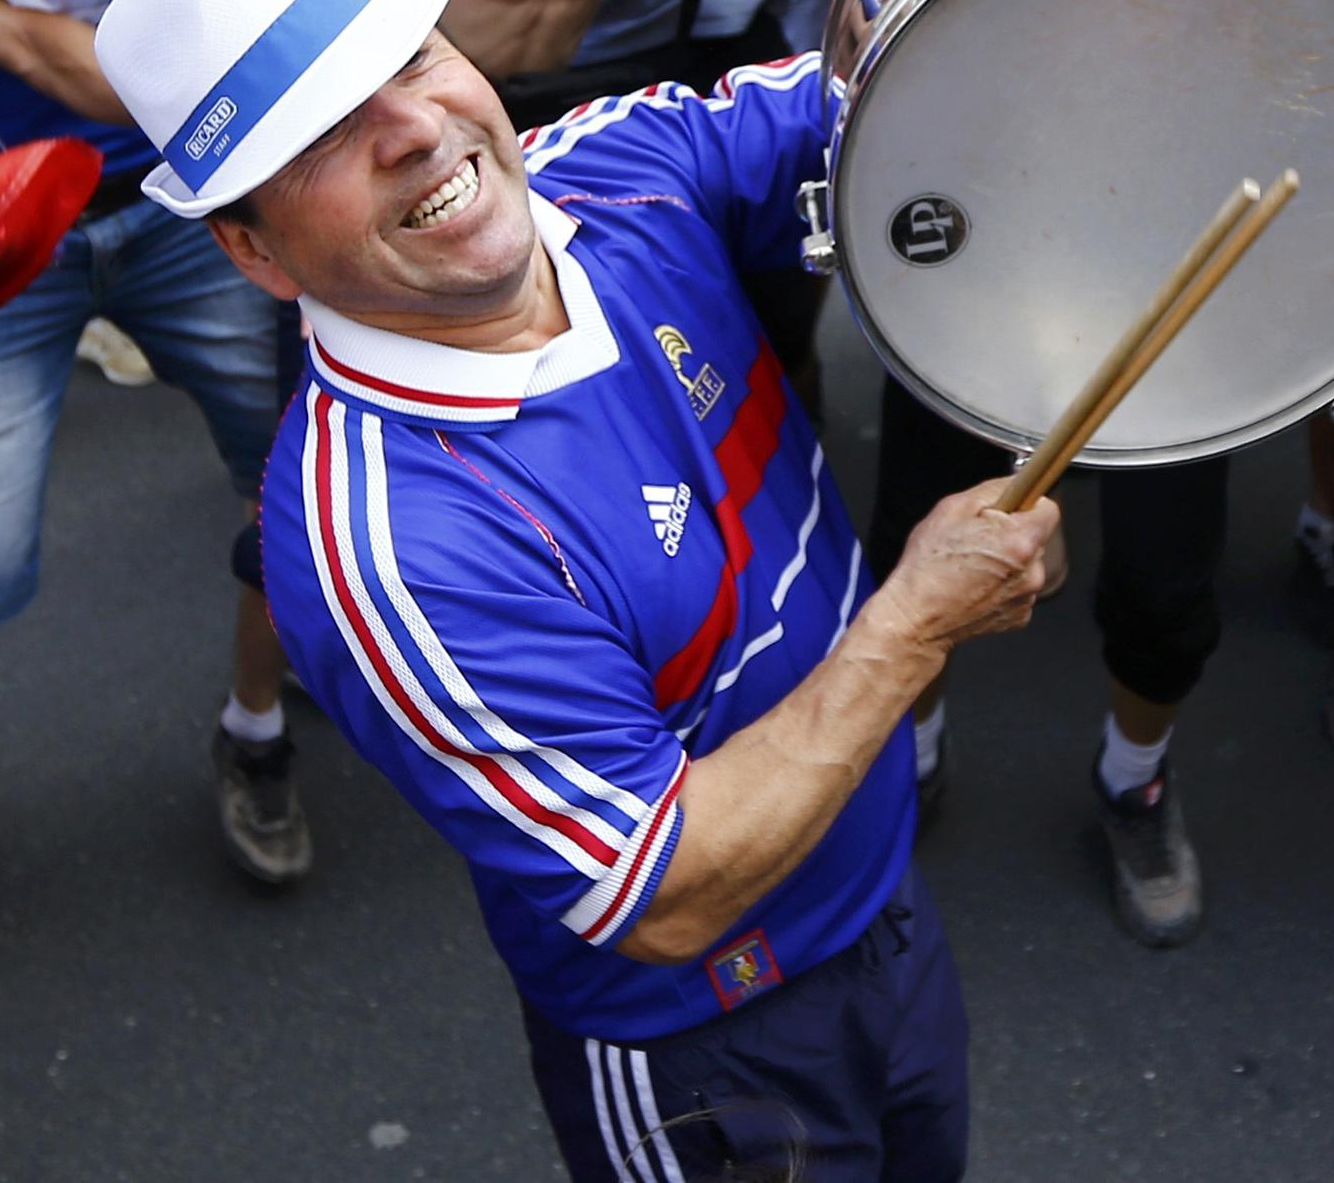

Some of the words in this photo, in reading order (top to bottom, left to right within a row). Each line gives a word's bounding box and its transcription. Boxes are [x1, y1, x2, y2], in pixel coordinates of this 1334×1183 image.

[188, 102, 232, 156] RICARD
[213, 133, 231, 157] STAFF
[906, 201, 954, 258] LP
[663, 482, 692, 557] adidas
